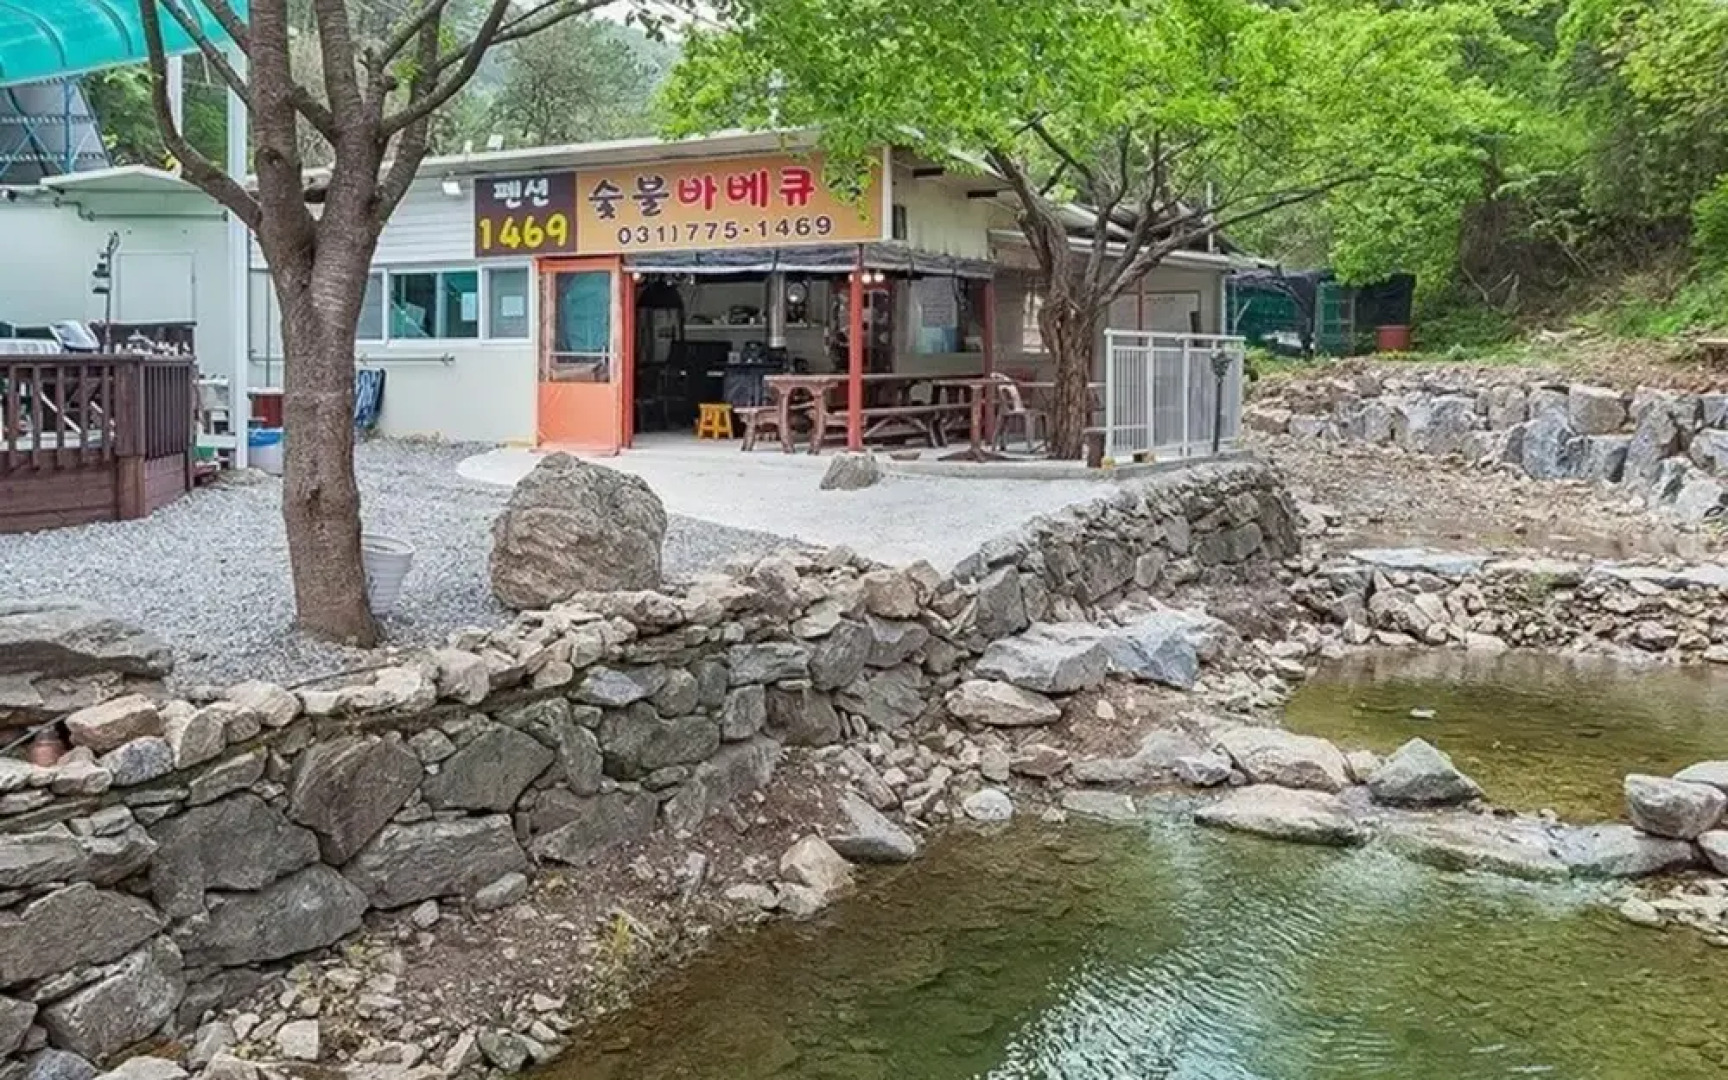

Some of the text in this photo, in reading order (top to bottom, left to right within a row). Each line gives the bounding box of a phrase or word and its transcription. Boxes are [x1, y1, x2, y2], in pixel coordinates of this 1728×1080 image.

[493, 178, 549, 209] 펜션
[480, 213, 568, 250] 1469
[618, 215, 832, 245] 031)775-1469
